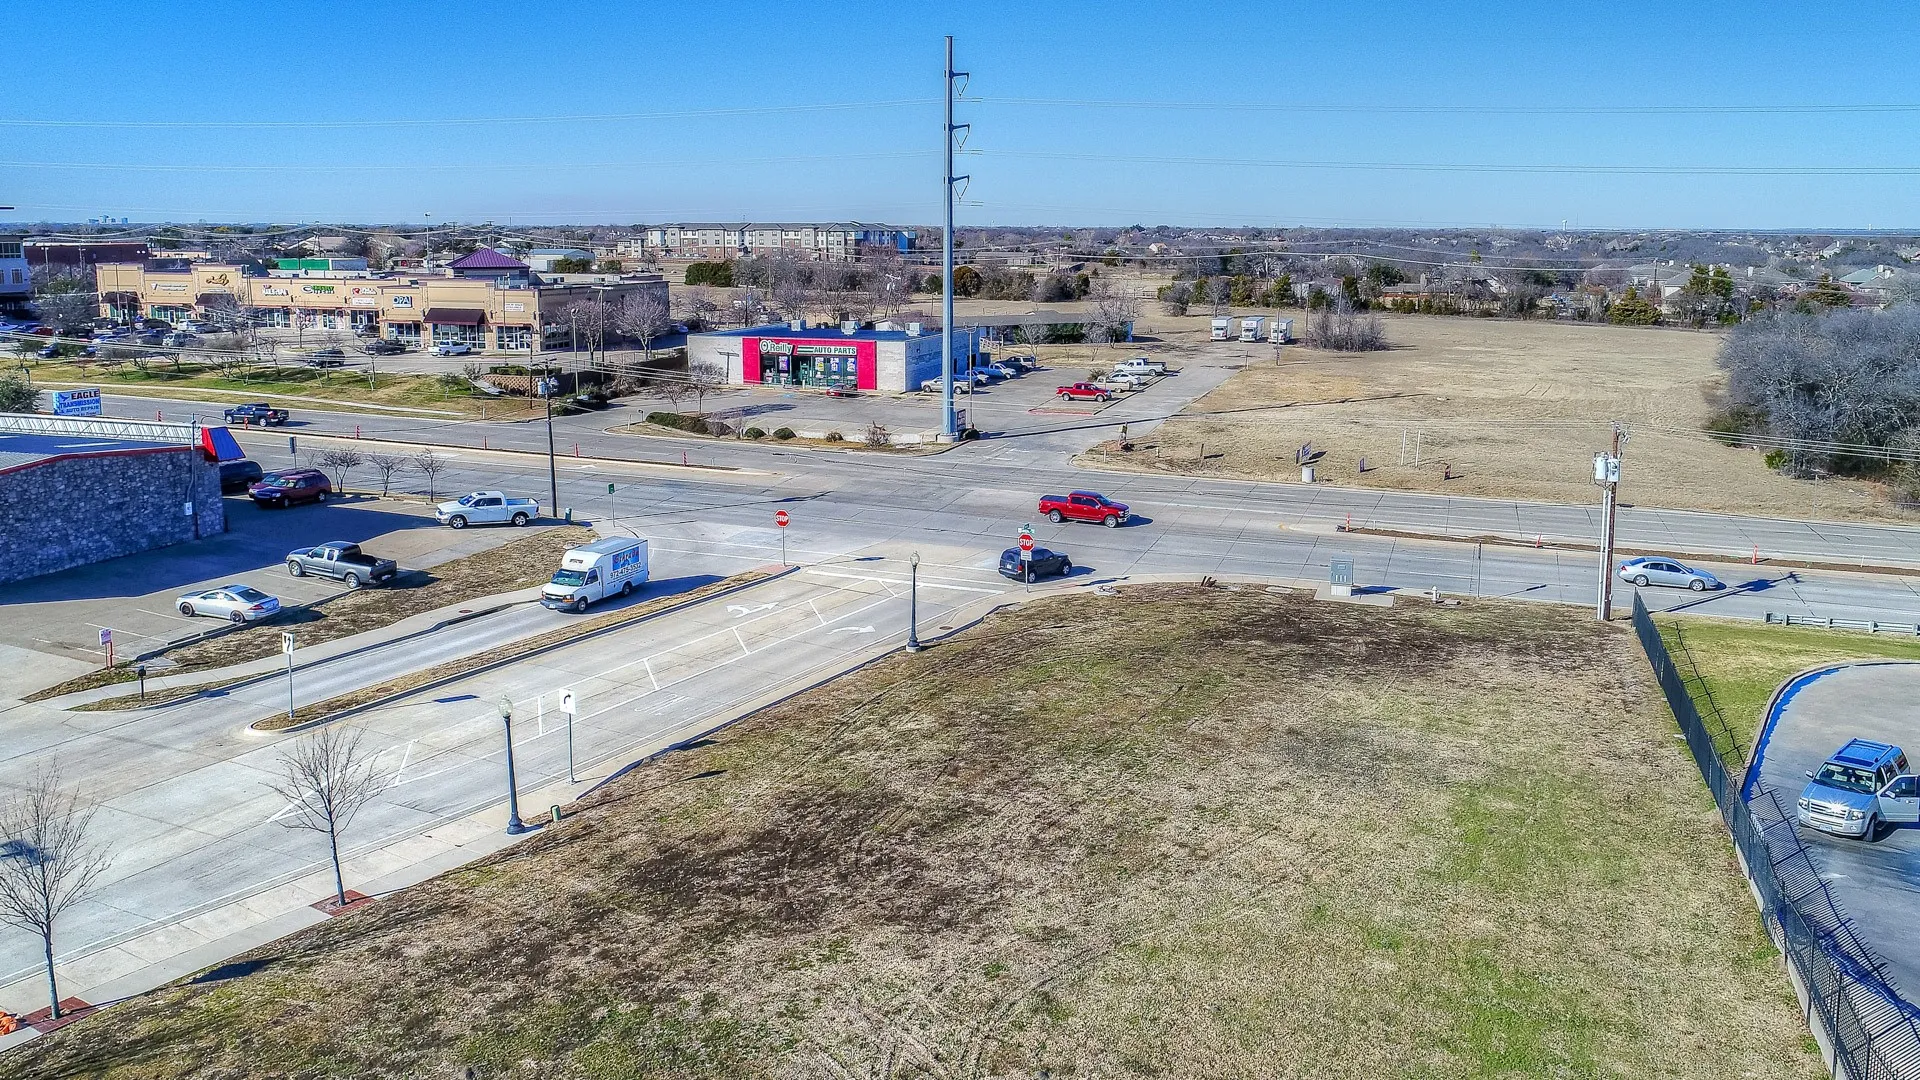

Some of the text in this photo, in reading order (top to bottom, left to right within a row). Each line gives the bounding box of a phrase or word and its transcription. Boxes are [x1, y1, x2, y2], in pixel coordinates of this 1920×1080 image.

[760, 340, 793, 354] O'Reilly
[813, 346, 856, 355] AUTO PARTS
[71, 390, 100, 400] EAGLE
[775, 514, 789, 523] STOP
[1019, 538, 1034, 547] STOP
